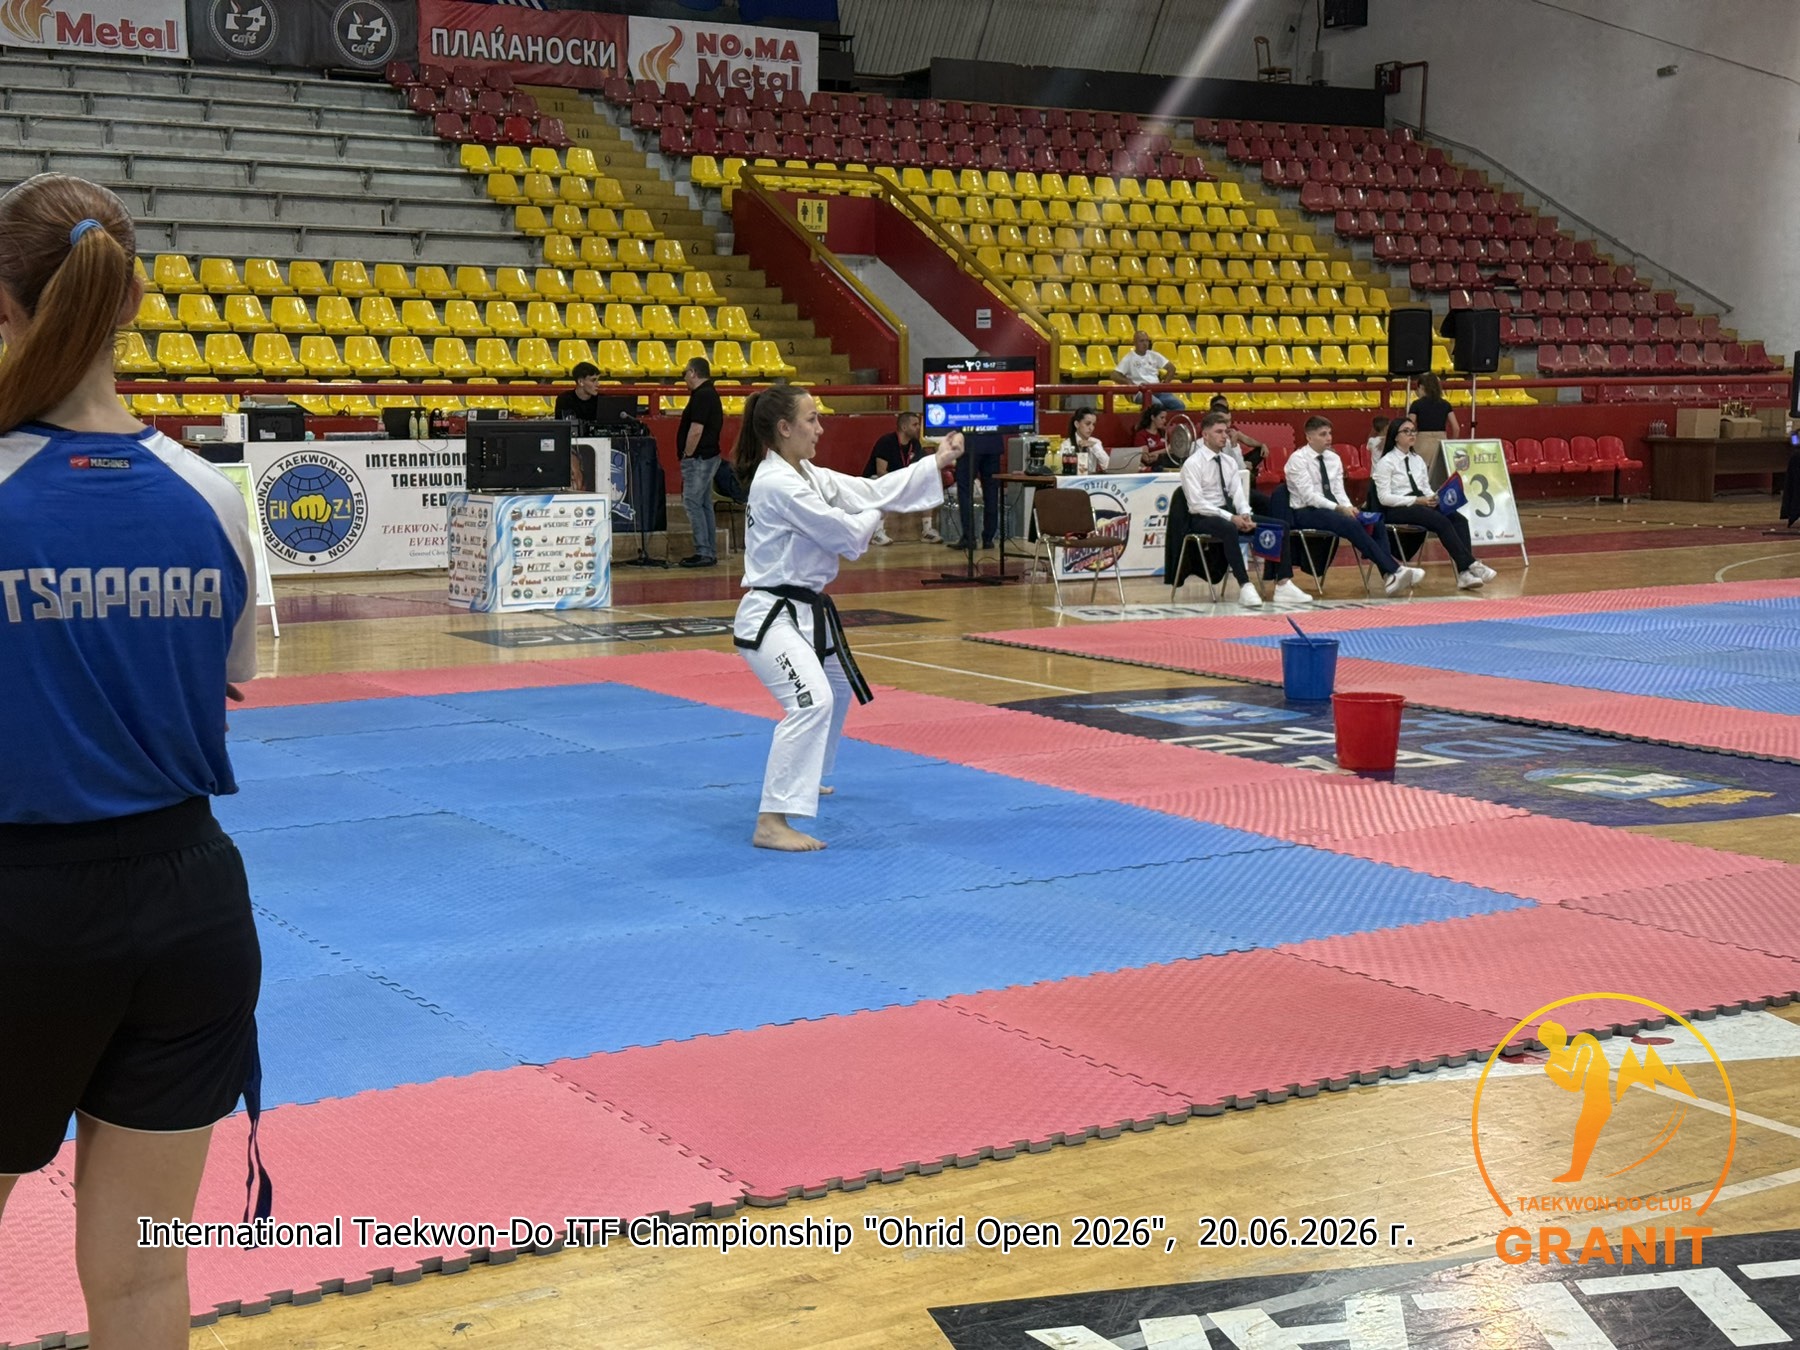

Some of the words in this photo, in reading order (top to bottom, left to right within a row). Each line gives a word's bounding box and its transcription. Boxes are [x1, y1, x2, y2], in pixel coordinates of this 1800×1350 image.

[55, 11, 178, 51] Metal
[231, 32, 257, 47] café
[351, 42, 376, 56] café
[431, 26, 616, 68] ПЛАЌАНОСКИ
[696, 32, 801, 63] NO.MA
[697, 57, 801, 91] Metal
[554, 102, 564, 112] 11
[577, 128, 589, 139] 10
[604, 155, 611, 166] 9
[635, 184, 642, 194] 8
[662, 213, 669, 224] 7
[691, 242, 699, 254] 6
[725, 274, 732, 287] 5
[753, 307, 761, 320] 4
[787, 341, 795, 354] 3
[1469, 473, 1495, 518] 3
[277, 454, 354, 483] TAEKWON-DO
[328, 491, 365, 559] FEDERATION
